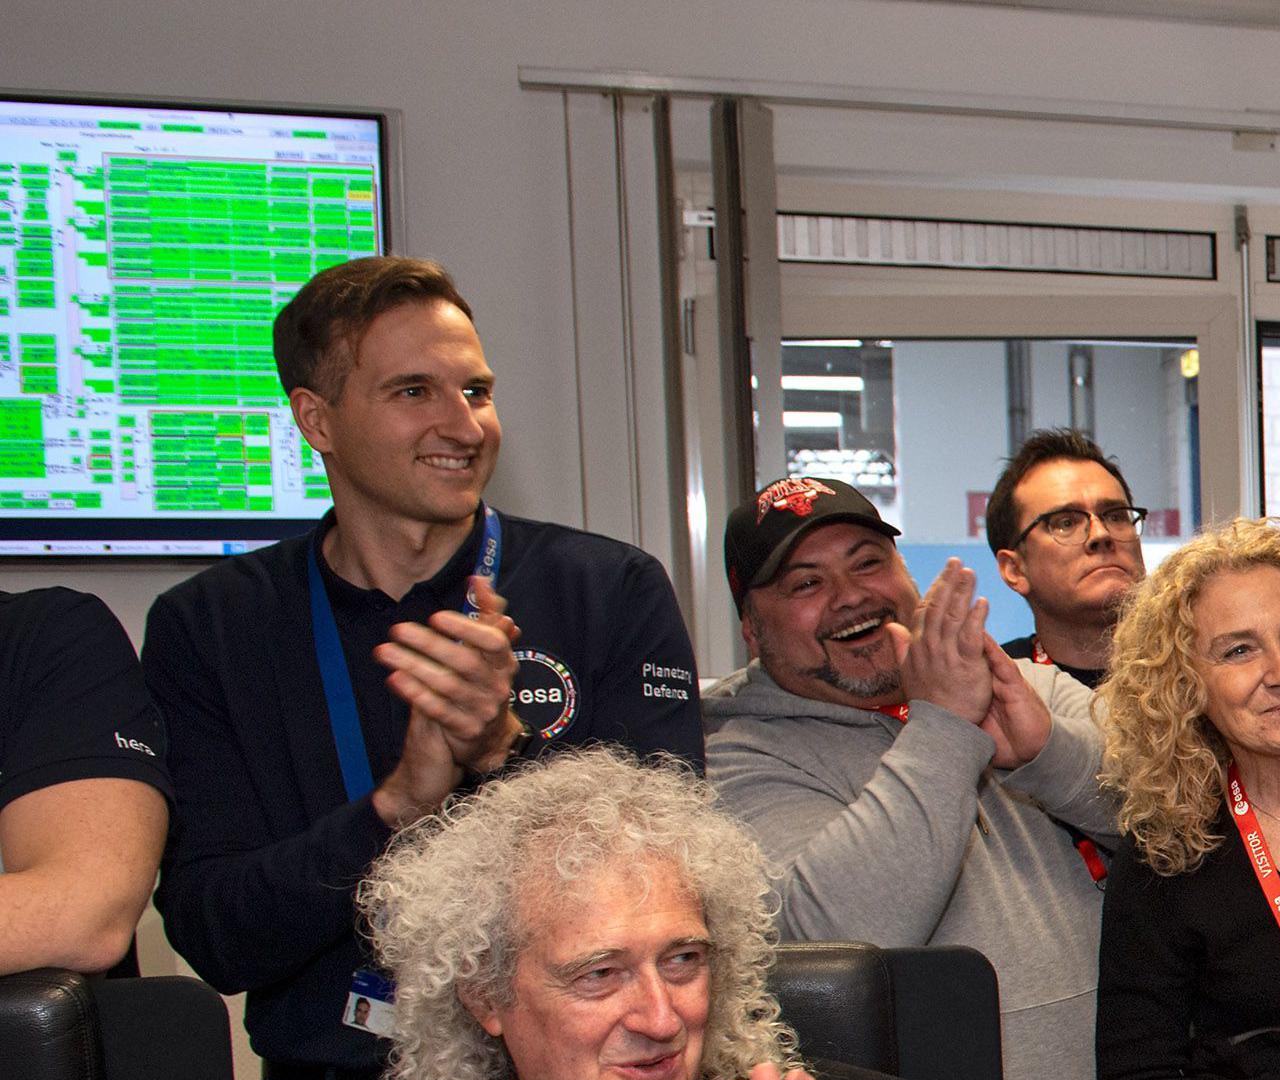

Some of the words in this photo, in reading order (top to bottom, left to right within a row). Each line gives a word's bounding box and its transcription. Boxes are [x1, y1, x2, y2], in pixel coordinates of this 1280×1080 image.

[642, 662, 692, 685] Planetary
[518, 687, 562, 704] esa
[643, 683, 689, 700] Defence
[114, 731, 156, 757] hera
[1247, 832, 1273, 878] VISITOR
